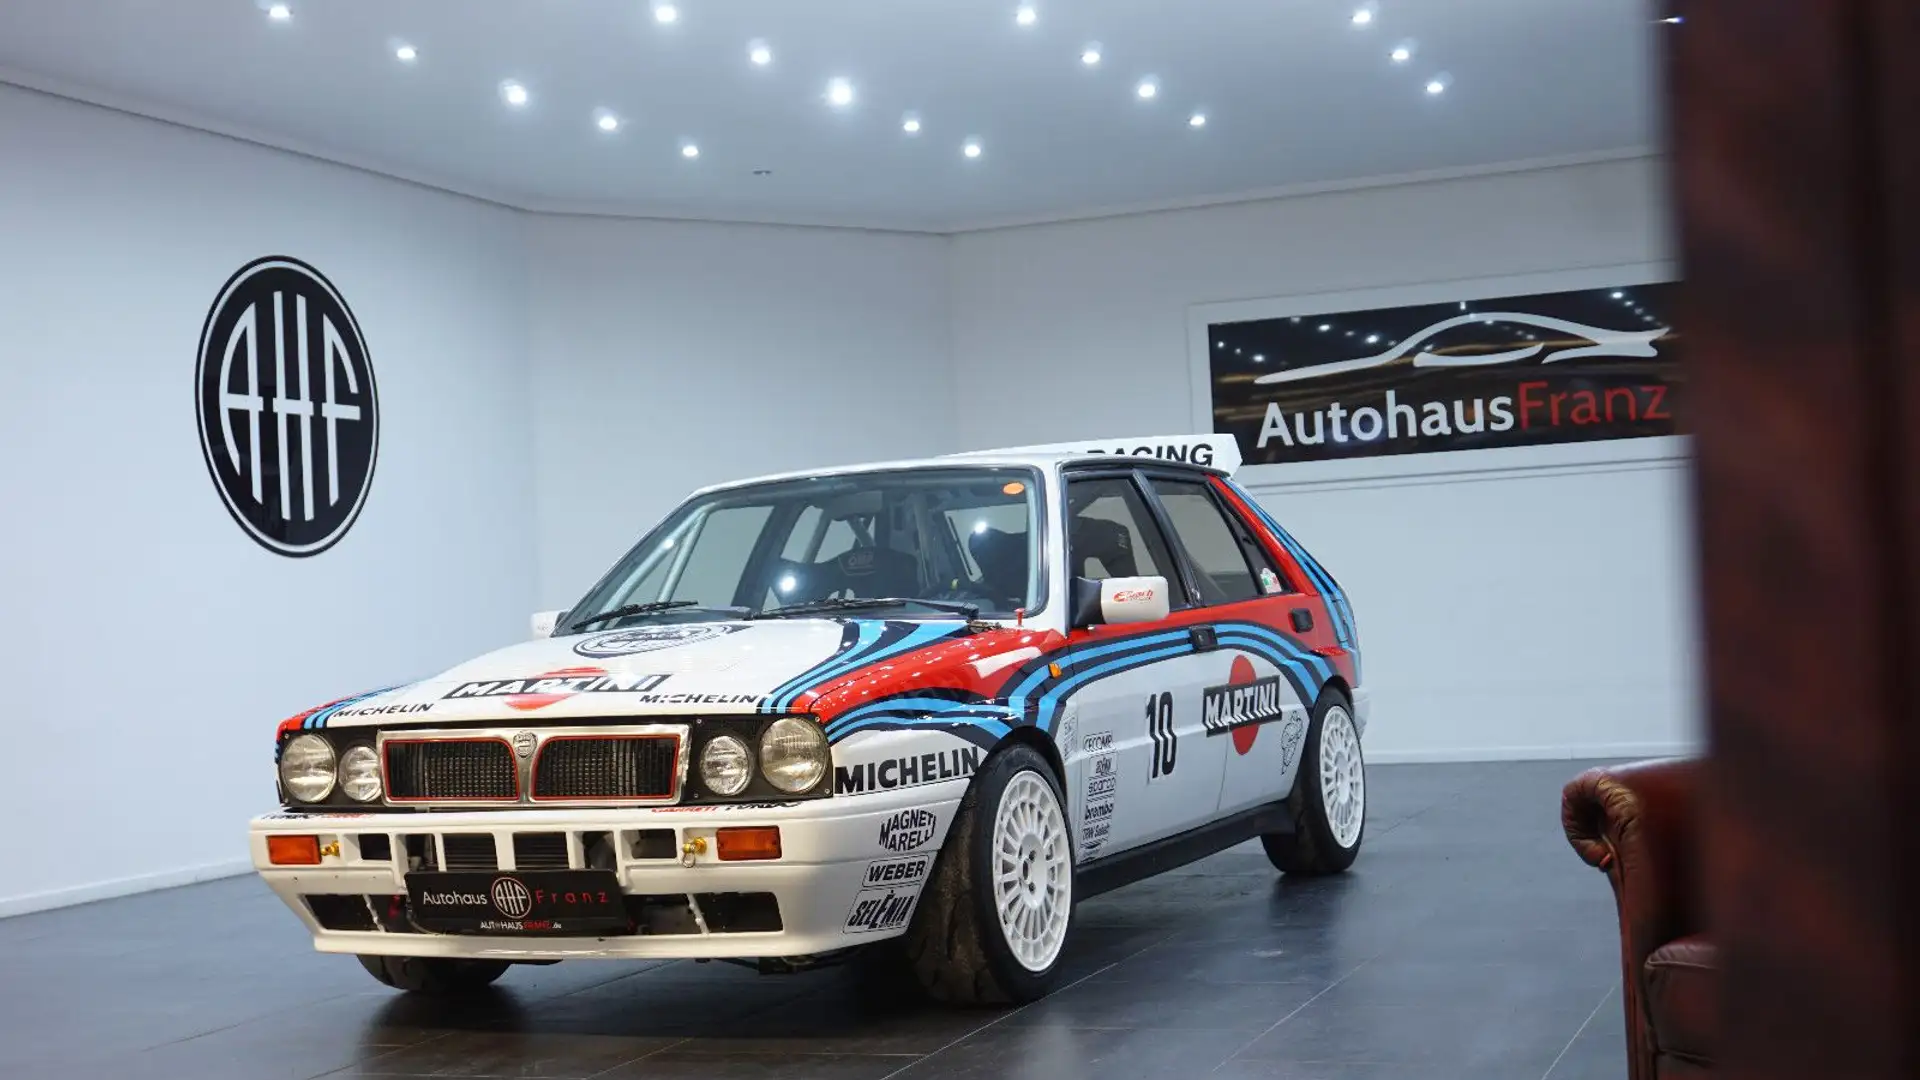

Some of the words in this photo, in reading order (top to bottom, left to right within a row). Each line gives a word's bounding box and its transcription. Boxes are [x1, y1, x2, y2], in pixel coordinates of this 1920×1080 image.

[333, 702, 435, 718] MICHELIN
[640, 693, 761, 705] MICHELIN
[1204, 681, 1280, 730] MARTINI
[1145, 690, 1177, 779] 10
[834, 746, 979, 794] MICHELIN
[1085, 801, 1114, 820] brembo
[879, 809, 937, 838] MAGNETI
[868, 860, 926, 882] WEBER
[423, 891, 487, 906] Autohaus
[535, 889, 608, 904] Franz
